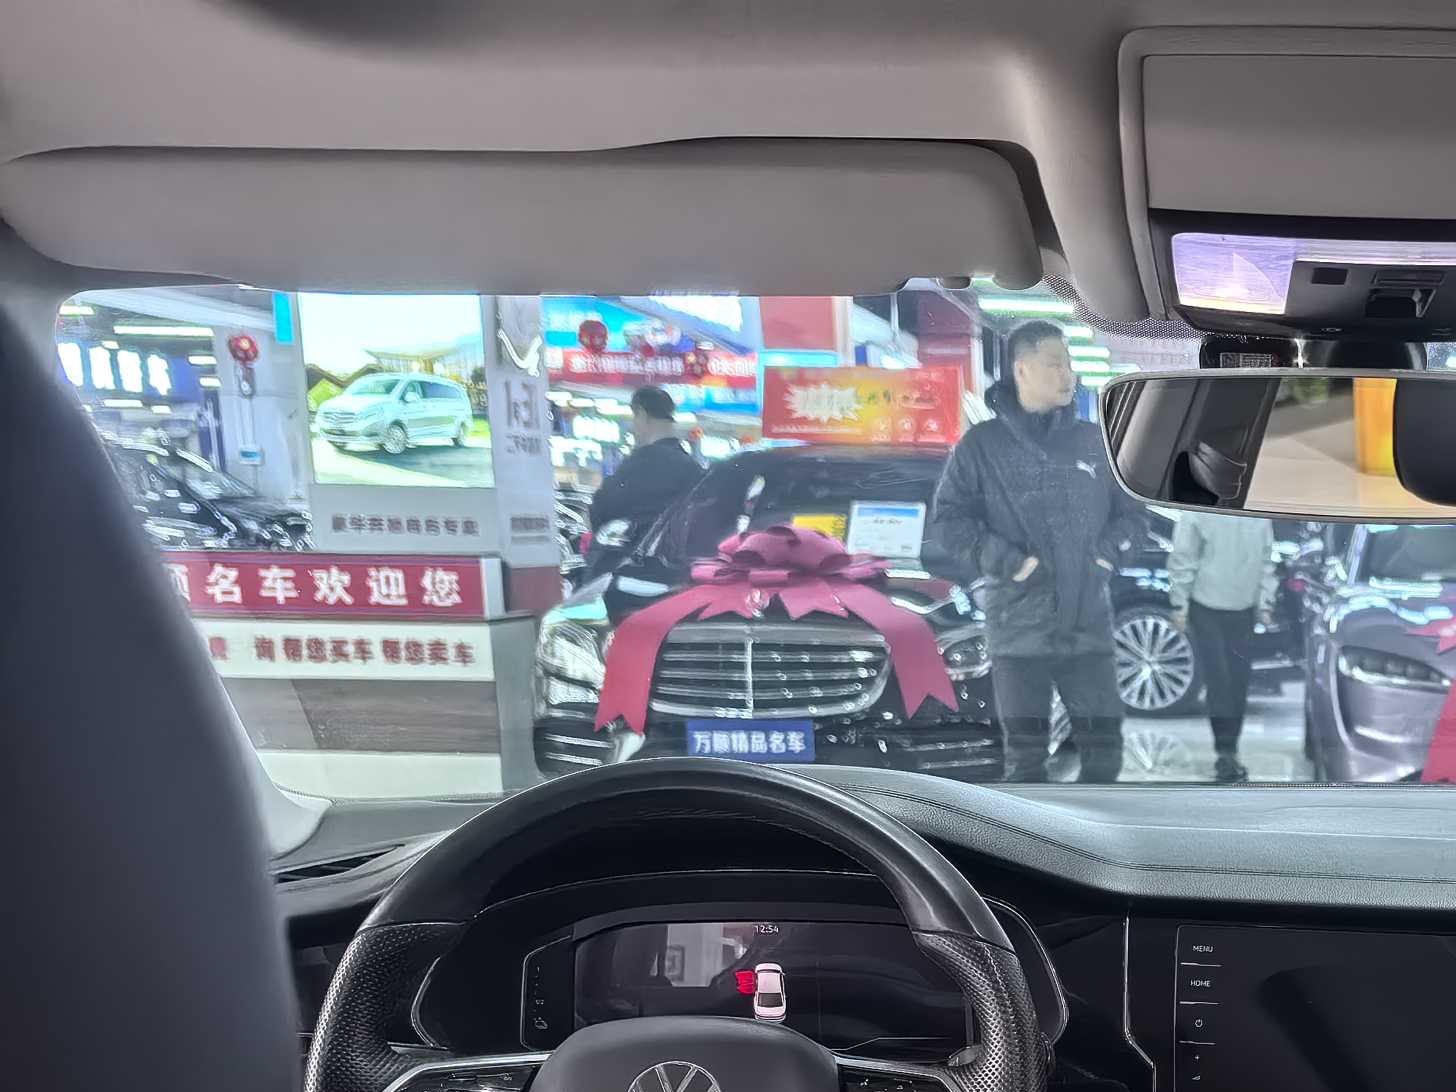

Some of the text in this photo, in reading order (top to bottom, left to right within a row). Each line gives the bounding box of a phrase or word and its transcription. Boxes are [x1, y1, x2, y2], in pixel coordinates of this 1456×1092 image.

[754, 924, 779, 934] 12:54
[1192, 945, 1214, 953] MENU
[1190, 979, 1211, 987] HOME
